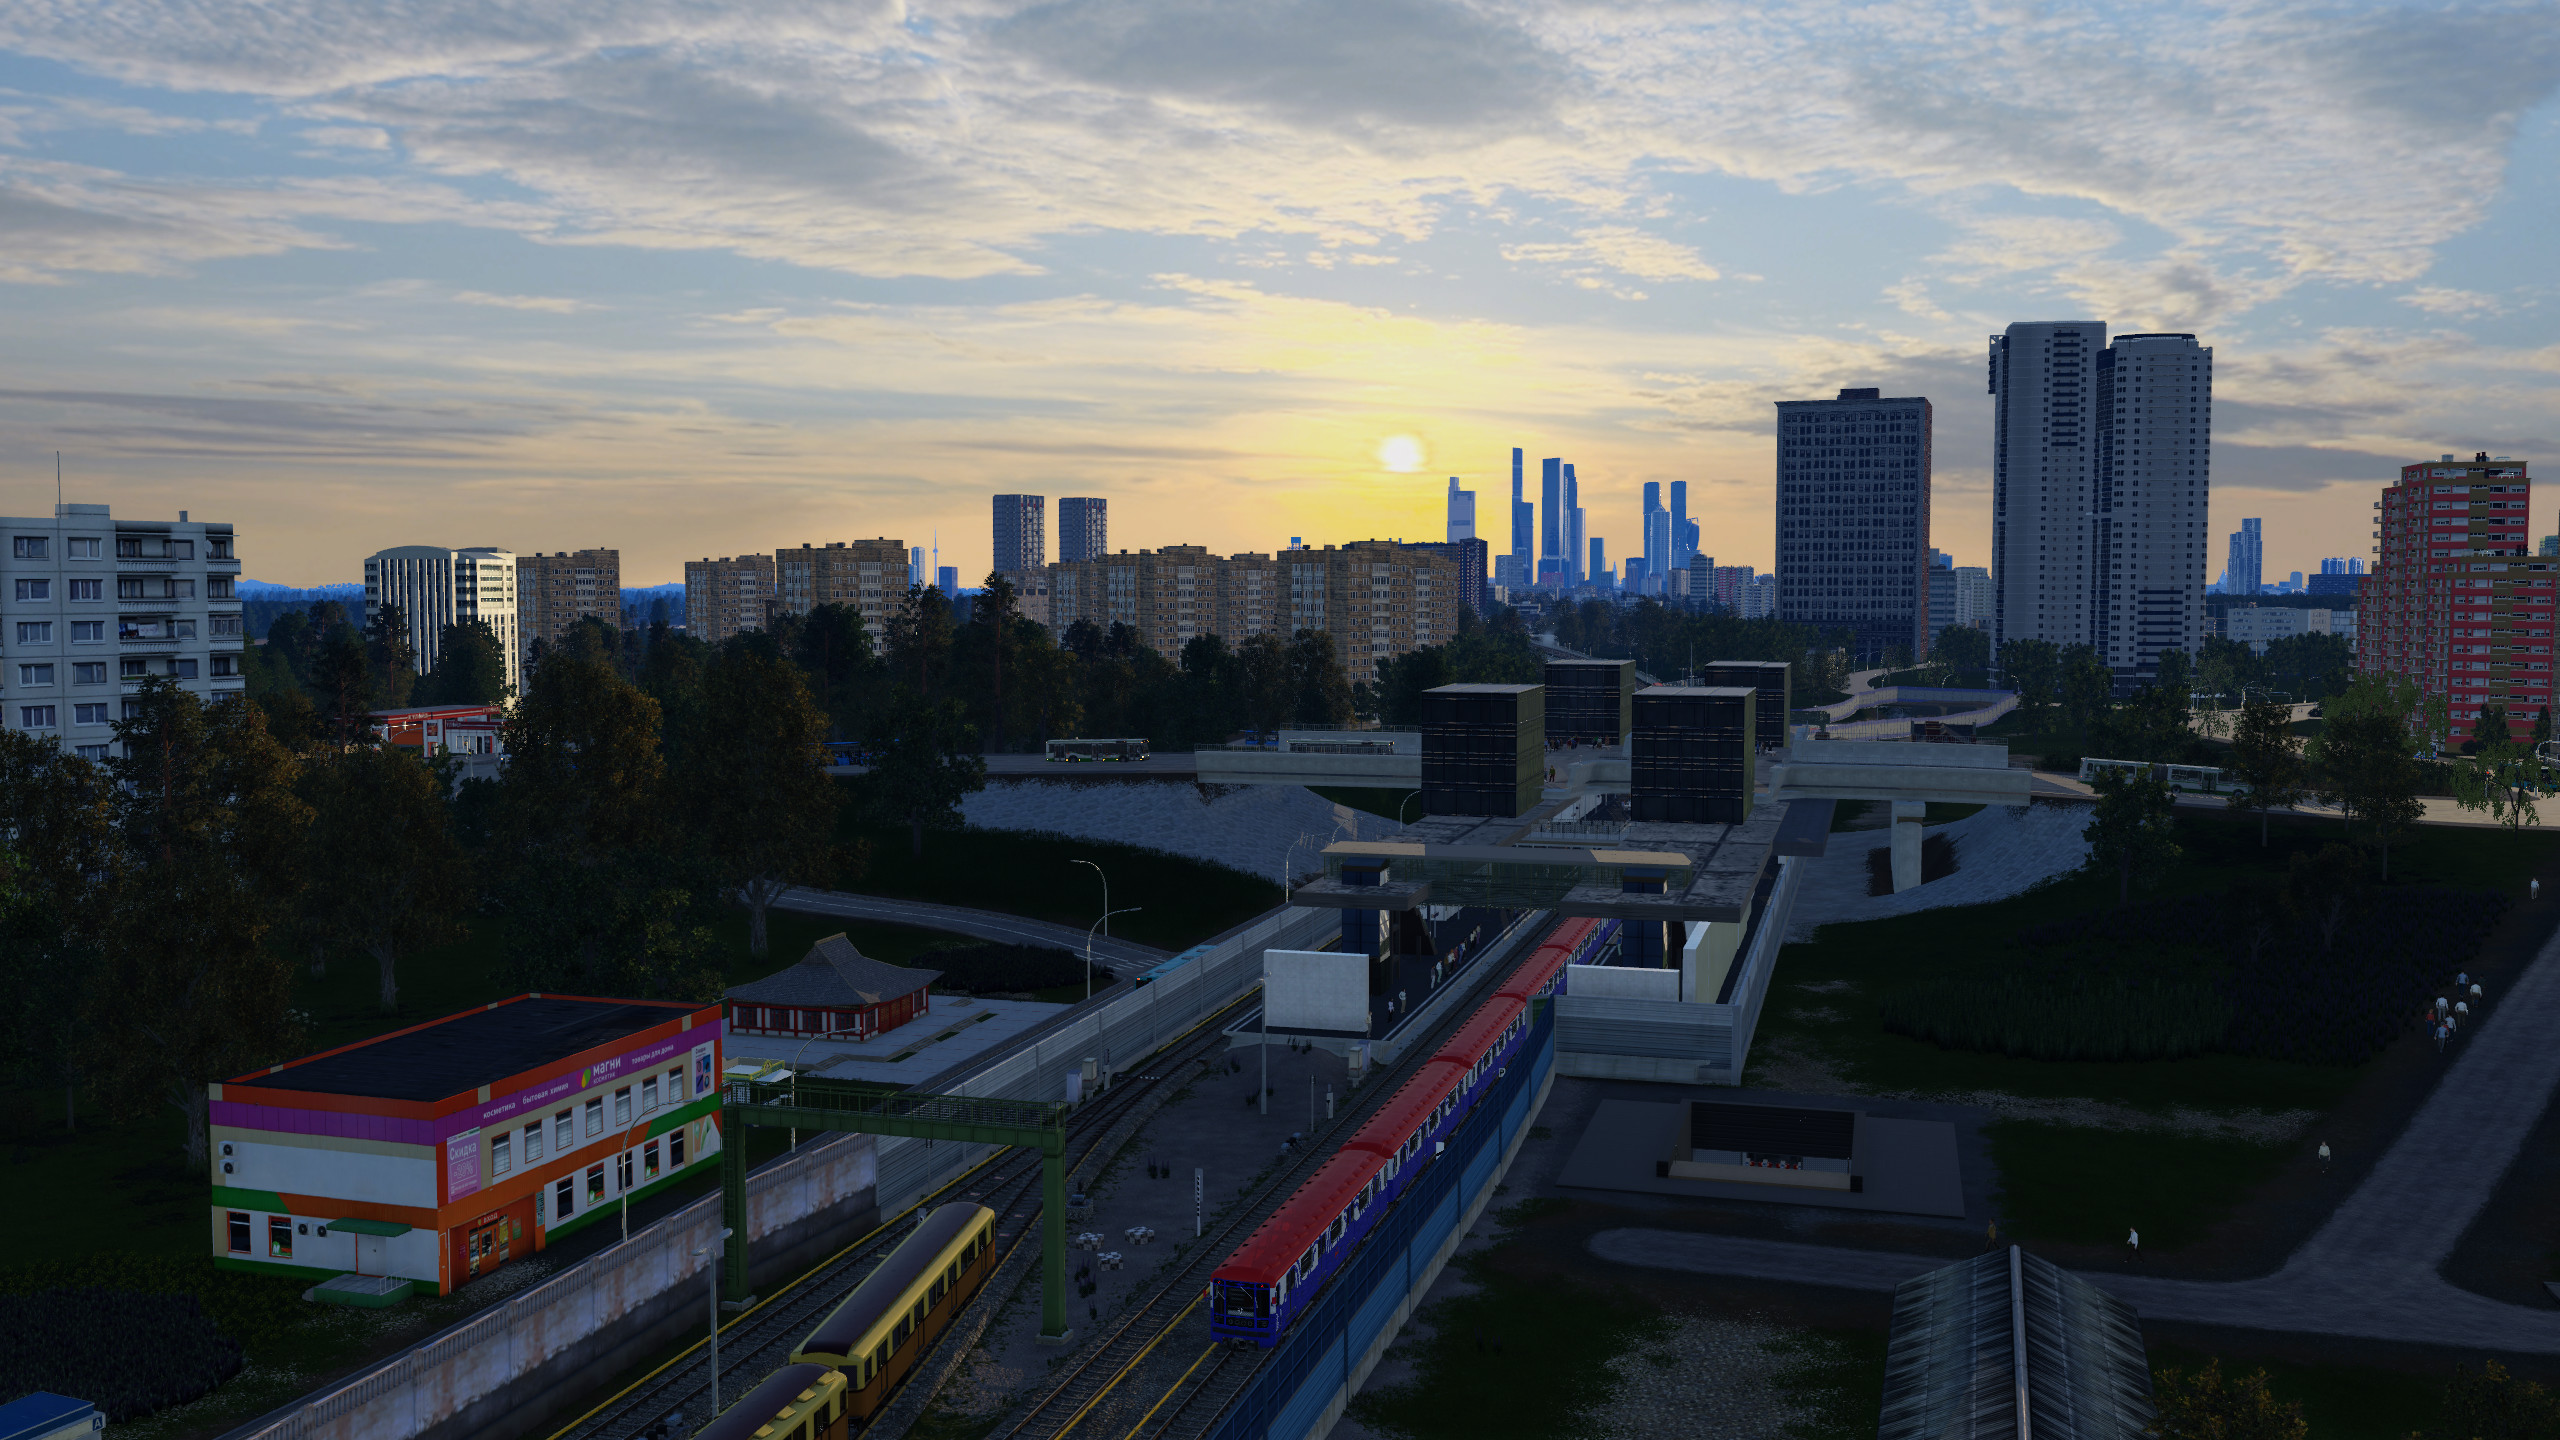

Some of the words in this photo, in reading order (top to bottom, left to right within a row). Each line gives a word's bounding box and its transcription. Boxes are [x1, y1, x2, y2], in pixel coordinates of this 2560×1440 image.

[631, 1053, 651, 1065] товары
[522, 1090, 549, 1105] бытовая
[549, 1082, 569, 1095] химия
[483, 1102, 516, 1119] косметика
[449, 1142, 477, 1161] Скидка
